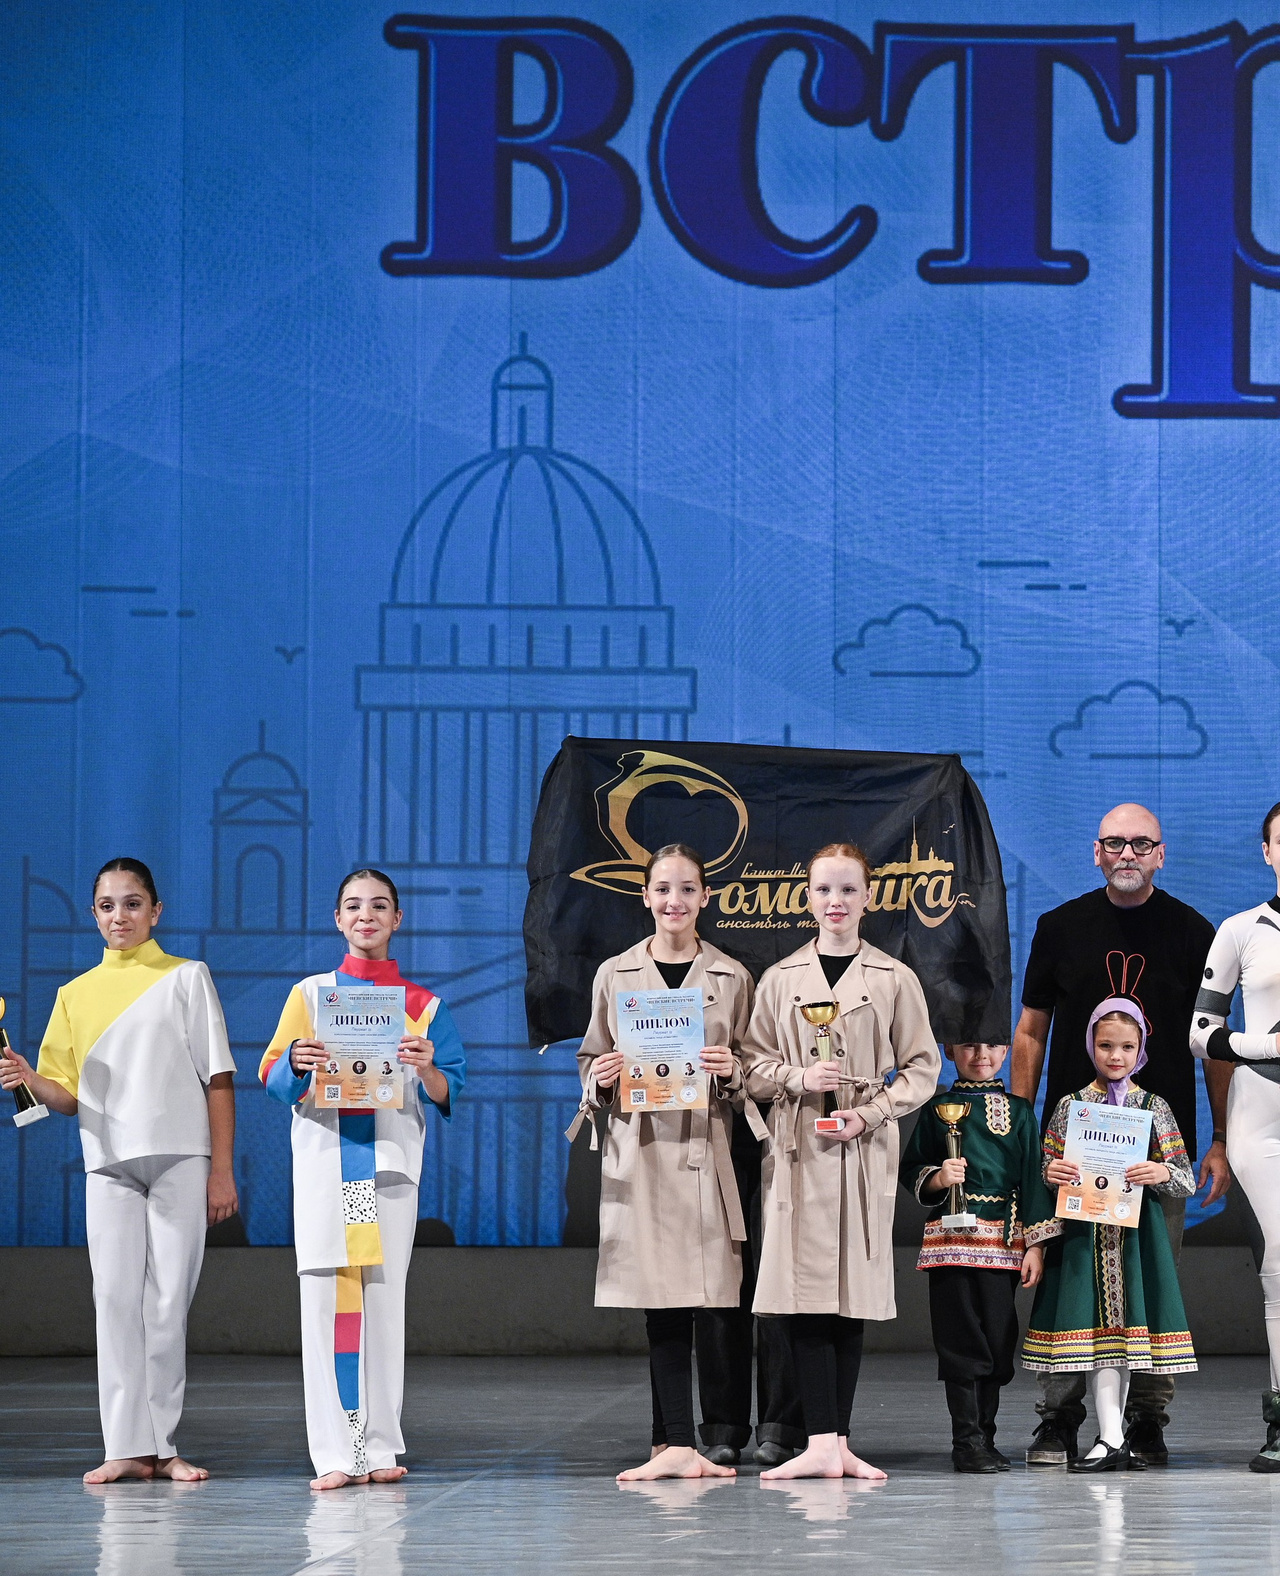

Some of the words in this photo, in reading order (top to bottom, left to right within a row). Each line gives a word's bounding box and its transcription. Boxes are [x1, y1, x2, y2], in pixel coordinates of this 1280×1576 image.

[716, 914, 791, 929] ансамбль
[330, 1015, 391, 1027] ДИПЛОМ
[631, 1017, 690, 1032] ДИПЛОМ
[1079, 1129, 1136, 1146] ДИПЛОМ
